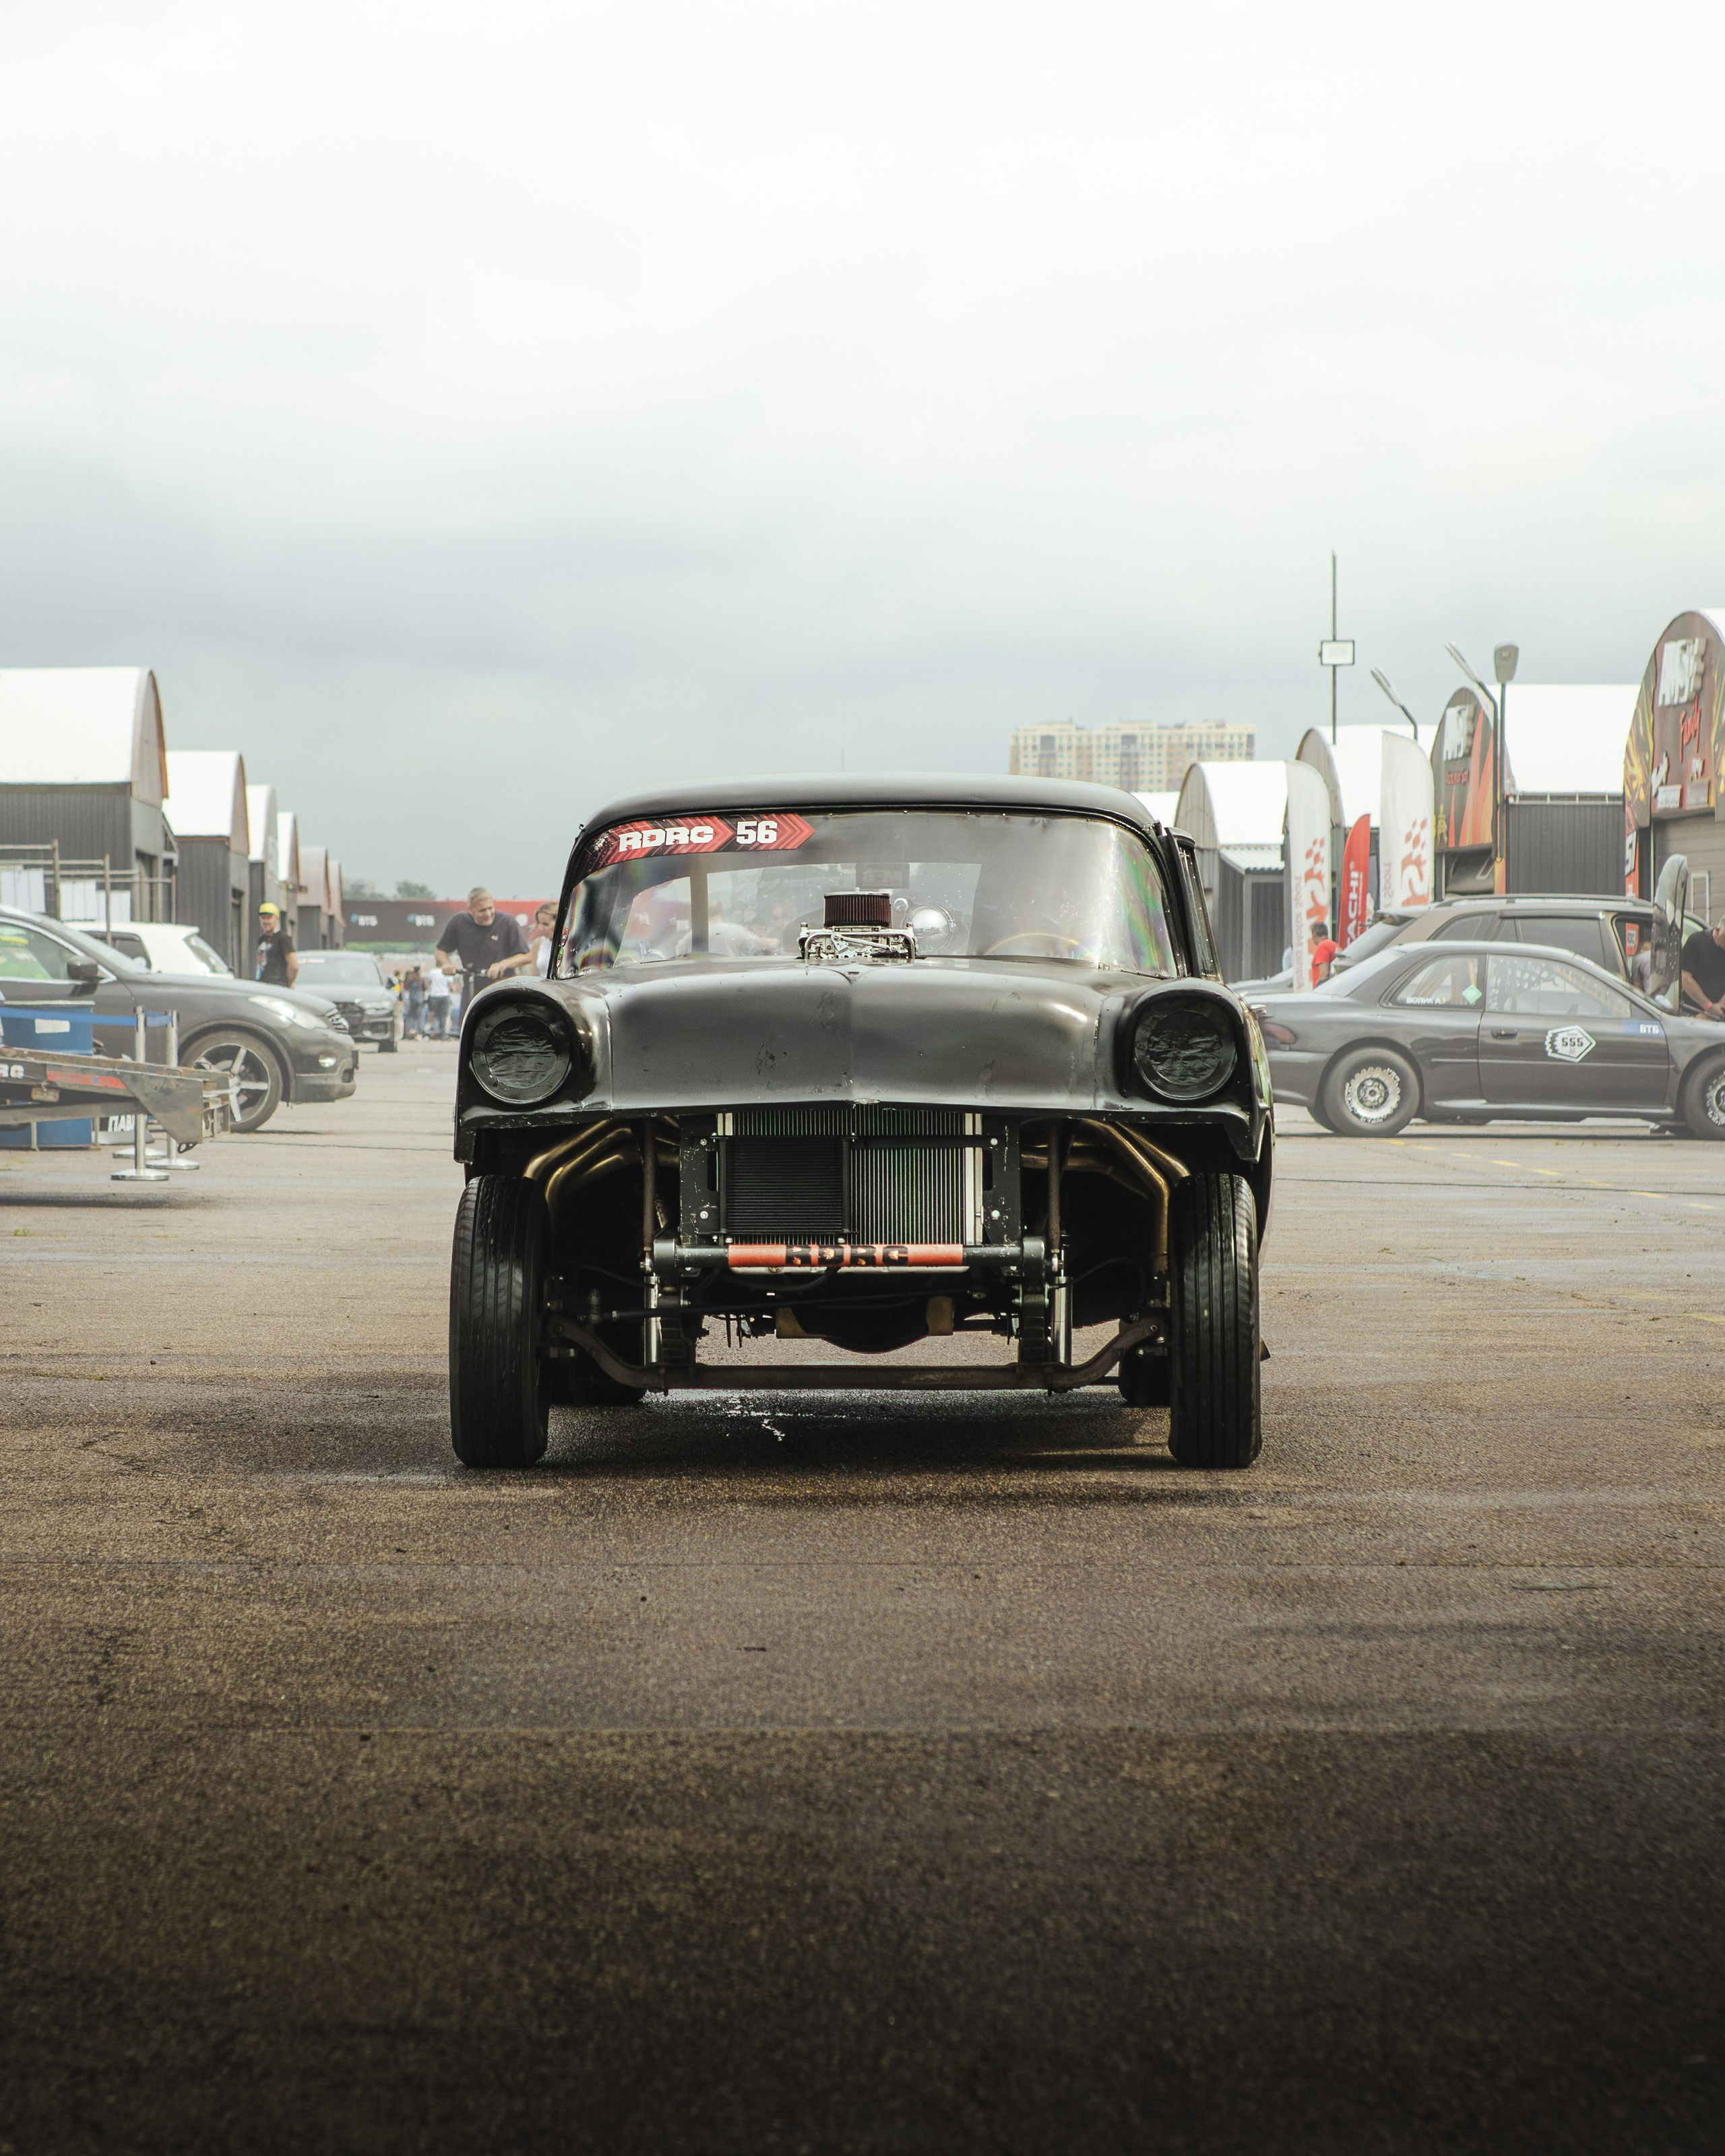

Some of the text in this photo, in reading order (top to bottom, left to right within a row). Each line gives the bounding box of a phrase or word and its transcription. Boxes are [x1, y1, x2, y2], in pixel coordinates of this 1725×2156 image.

[619, 820, 778, 852] RDRC 56
[1639, 1024, 1659, 1034] ВТБ
[1562, 1038, 1583, 1047] 555
